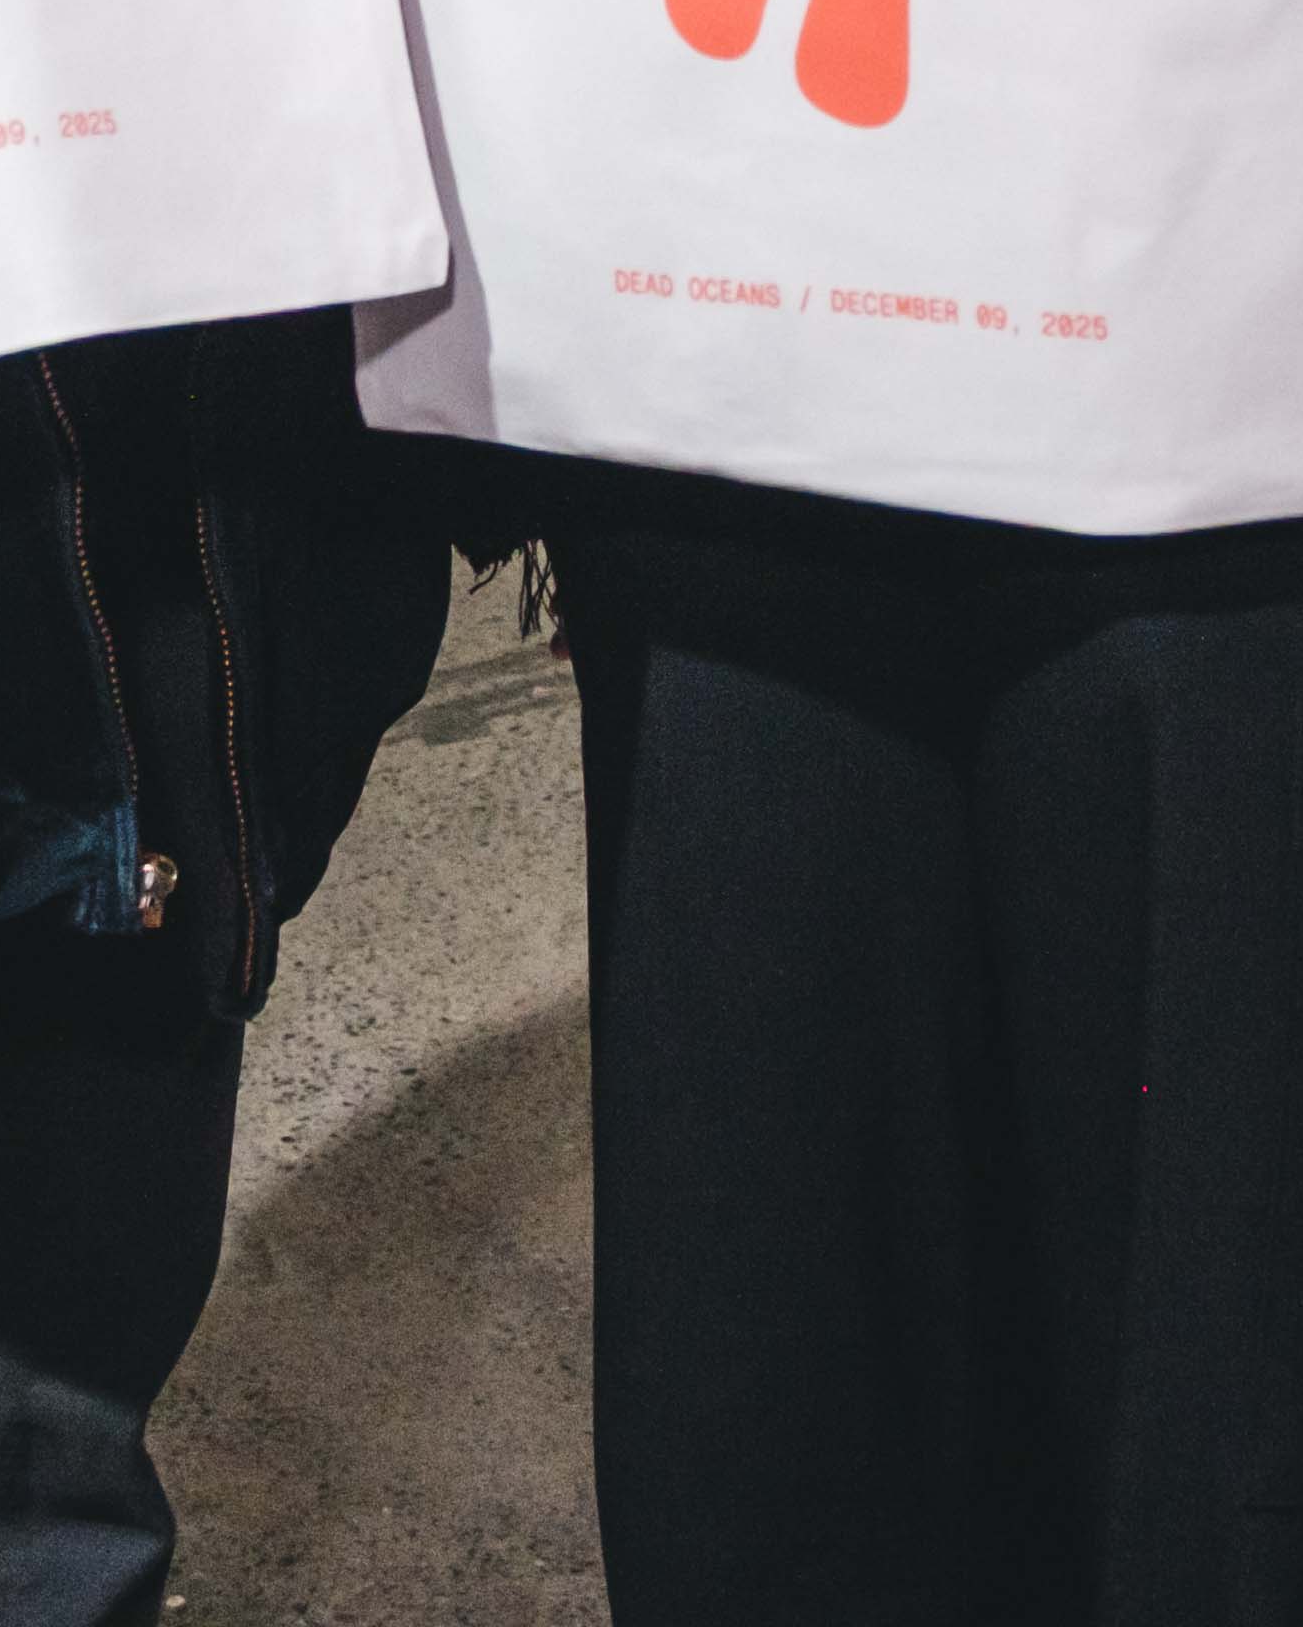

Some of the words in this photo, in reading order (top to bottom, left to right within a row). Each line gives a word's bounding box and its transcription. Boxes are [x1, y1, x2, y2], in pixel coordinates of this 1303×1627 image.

[59, 109, 118, 140] 2025
[613, 268, 675, 299] DEAD
[688, 275, 783, 309] OCEANS
[829, 287, 960, 325] DECEMBER
[974, 302, 1020, 335] 09,
[1041, 311, 1110, 342] 2025
